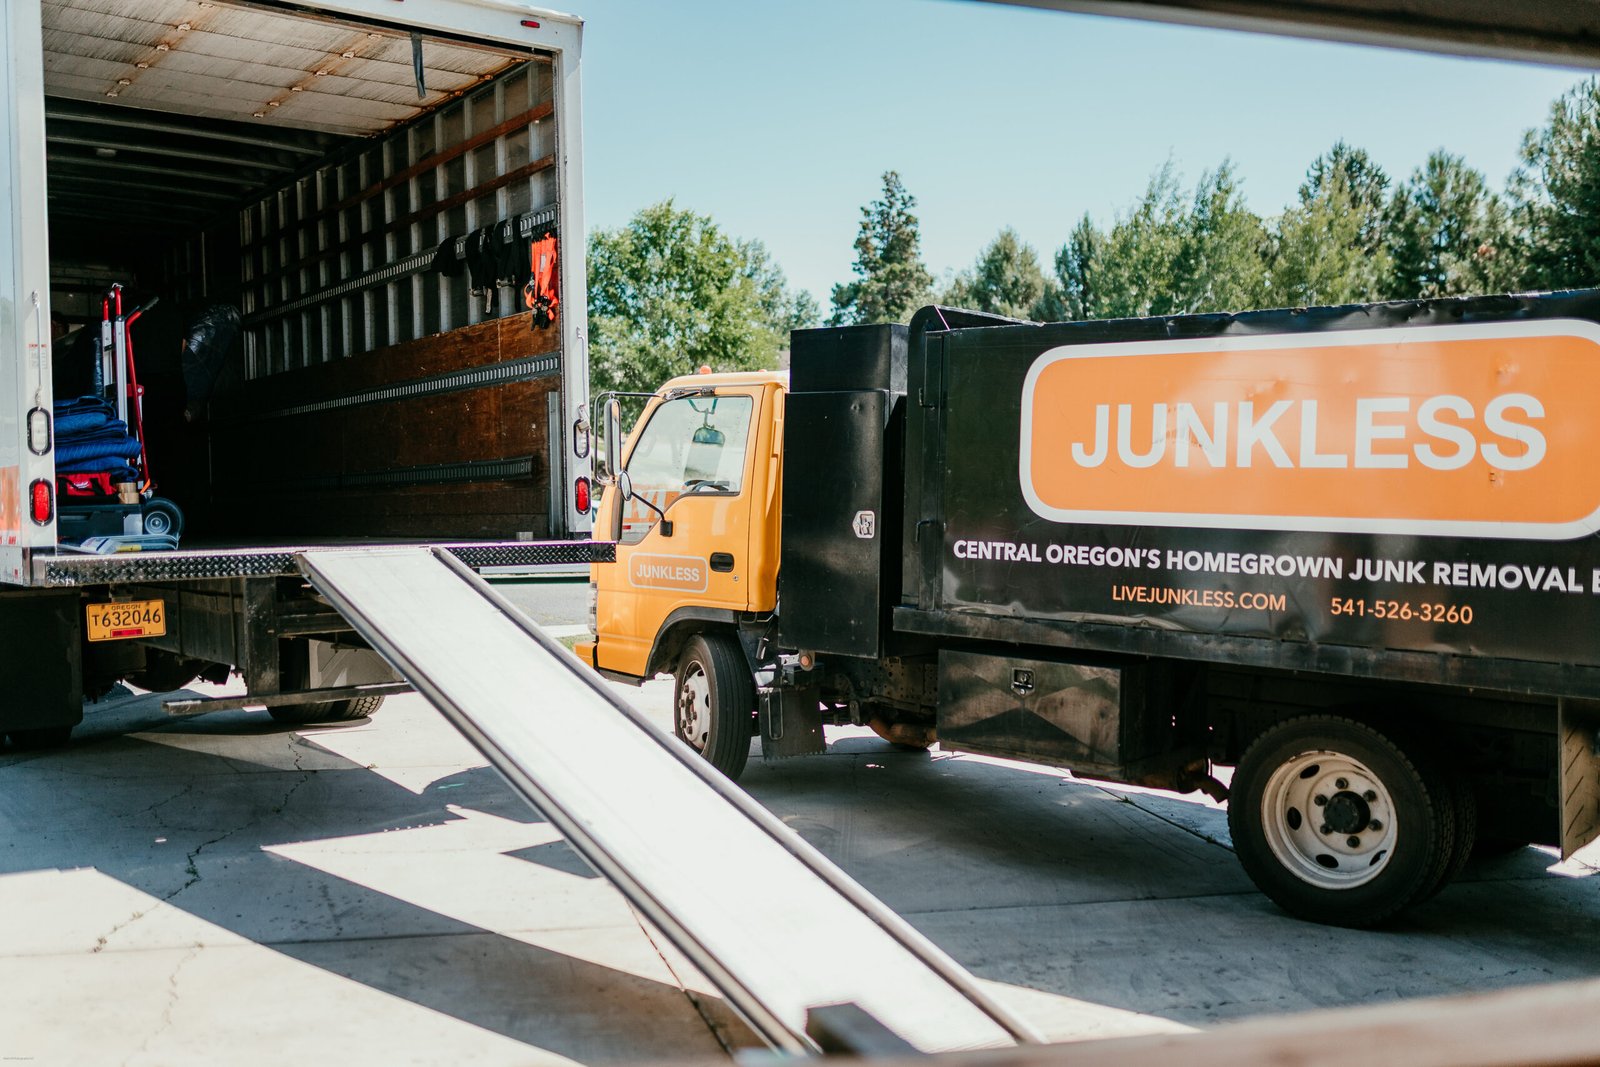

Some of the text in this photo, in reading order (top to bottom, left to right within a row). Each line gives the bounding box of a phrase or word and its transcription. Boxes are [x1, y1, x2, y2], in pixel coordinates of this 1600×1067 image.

[1071, 393, 1547, 471] JUNKLESS
[636, 563, 700, 582] JUNKLESS
[953, 540, 1042, 562] CENTRAL
[1046, 544, 1160, 569] OREGON'S
[1166, 550, 1342, 580] HOMEGROWN
[1348, 558, 1426, 584] JUNK
[1432, 562, 1584, 594] REMOVAL
[1112, 585, 1287, 612] LIVEJUNKLESS.COM
[1330, 597, 1474, 625] 541-526-3260
[92, 608, 161, 628] T632046
